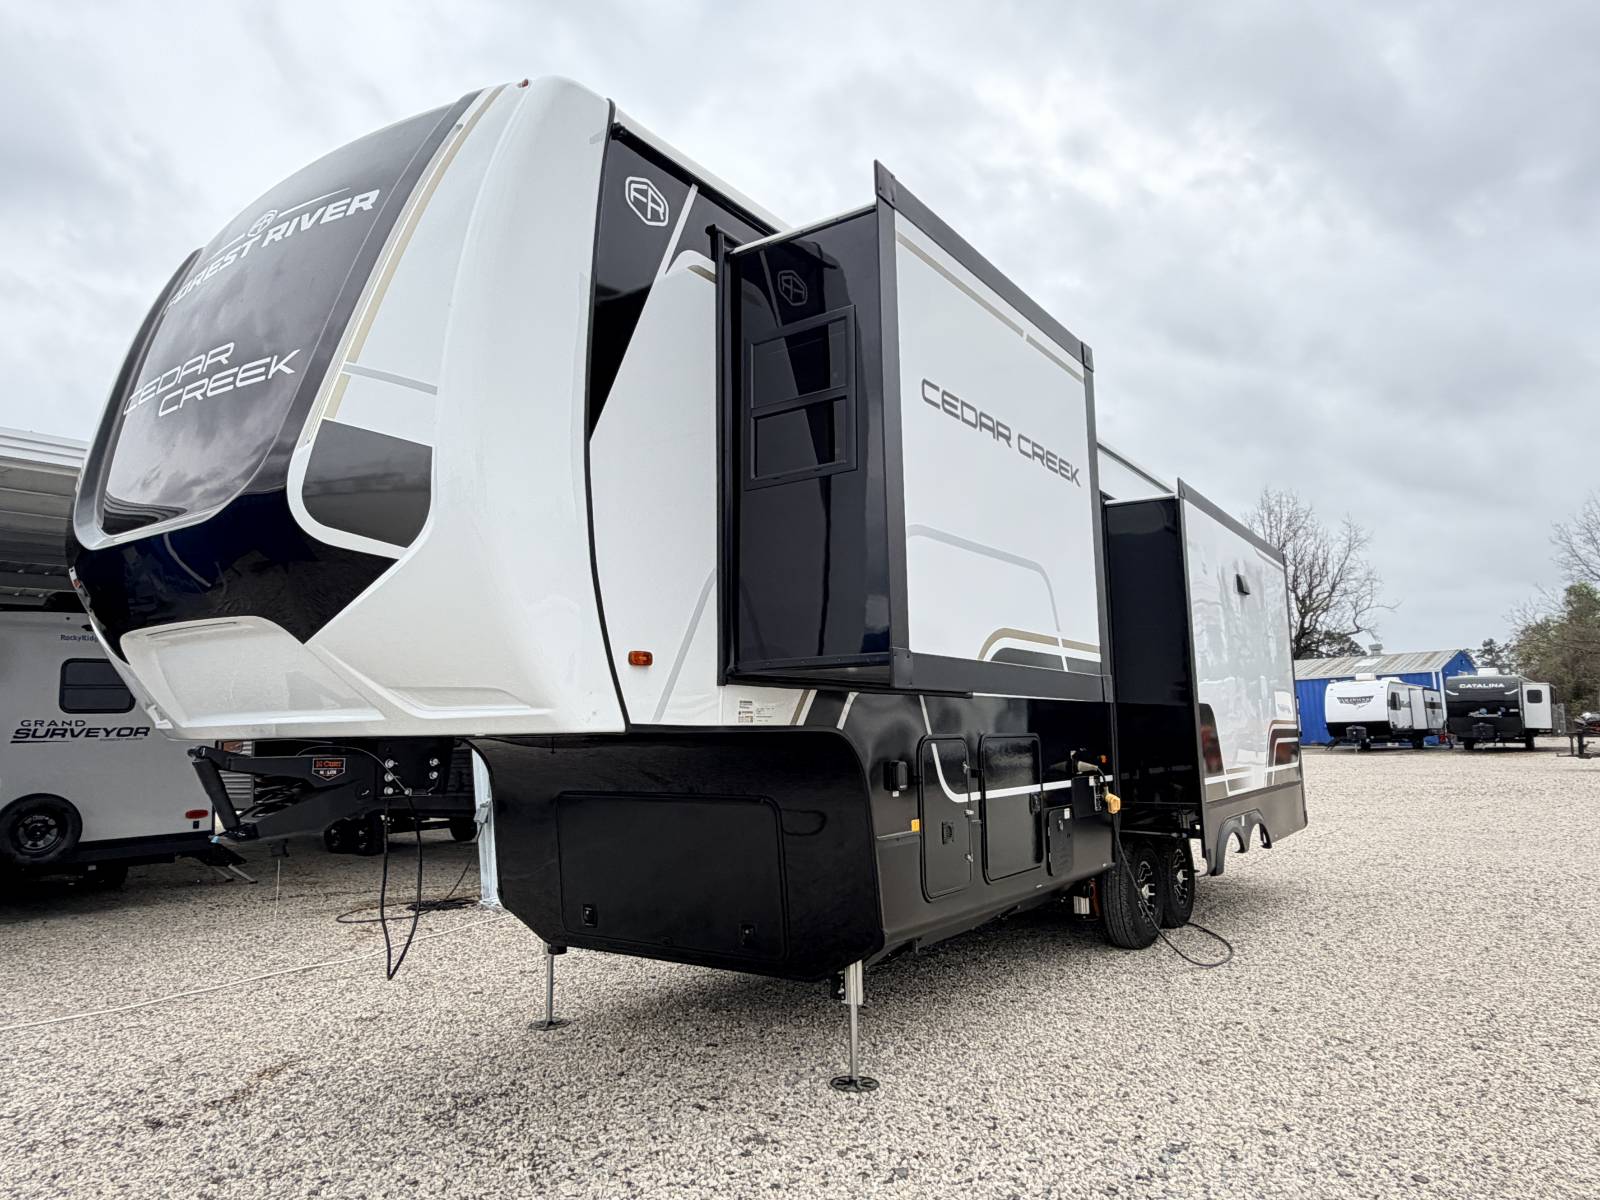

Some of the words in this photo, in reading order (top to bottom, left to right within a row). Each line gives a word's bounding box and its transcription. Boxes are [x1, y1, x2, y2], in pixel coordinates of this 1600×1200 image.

[261, 189, 380, 248] RIVER
[123, 342, 235, 415] CEDAR
[158, 349, 300, 417] CREEK
[921, 378, 1012, 448] CEDAR
[1017, 433, 1080, 488] CREEK
[12, 727, 151, 739] SURVEYOR
[20, 719, 87, 727] GRAND
